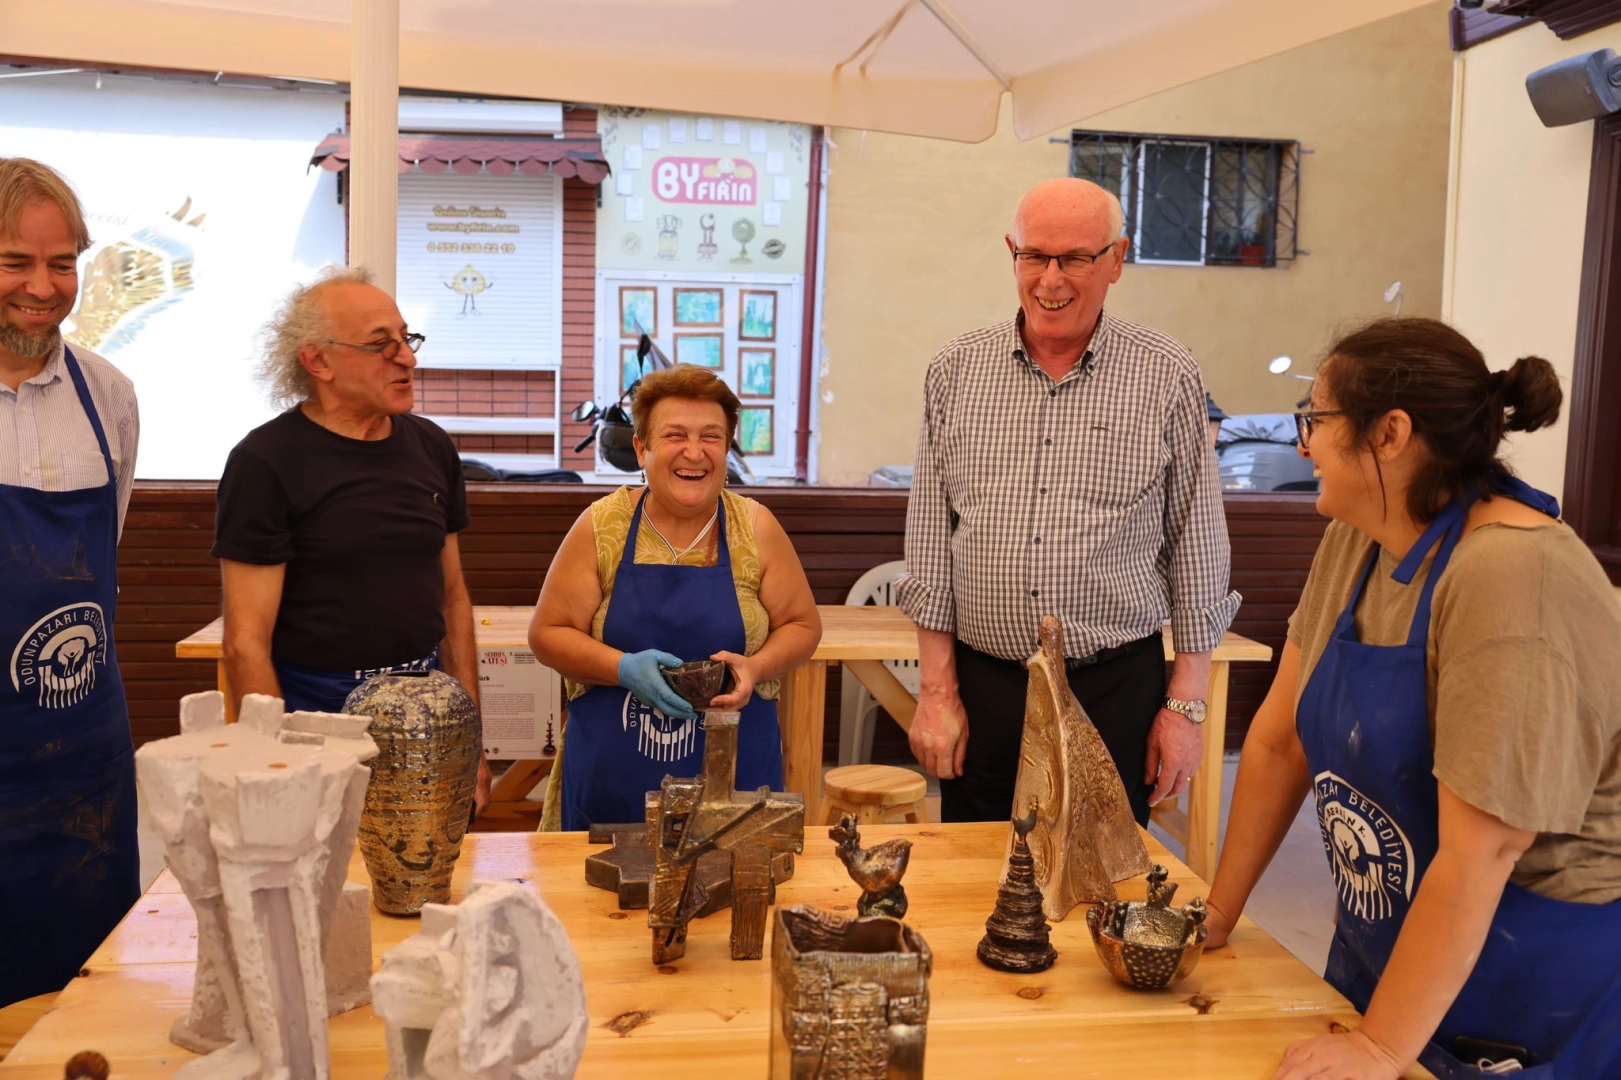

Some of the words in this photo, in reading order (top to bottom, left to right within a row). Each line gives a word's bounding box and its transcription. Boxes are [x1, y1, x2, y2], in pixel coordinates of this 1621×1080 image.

[657, 161, 700, 200] BY
[21, 611, 77, 686] ODUNPAZARI
[1348, 791, 1402, 895] BELEDİYESİ
